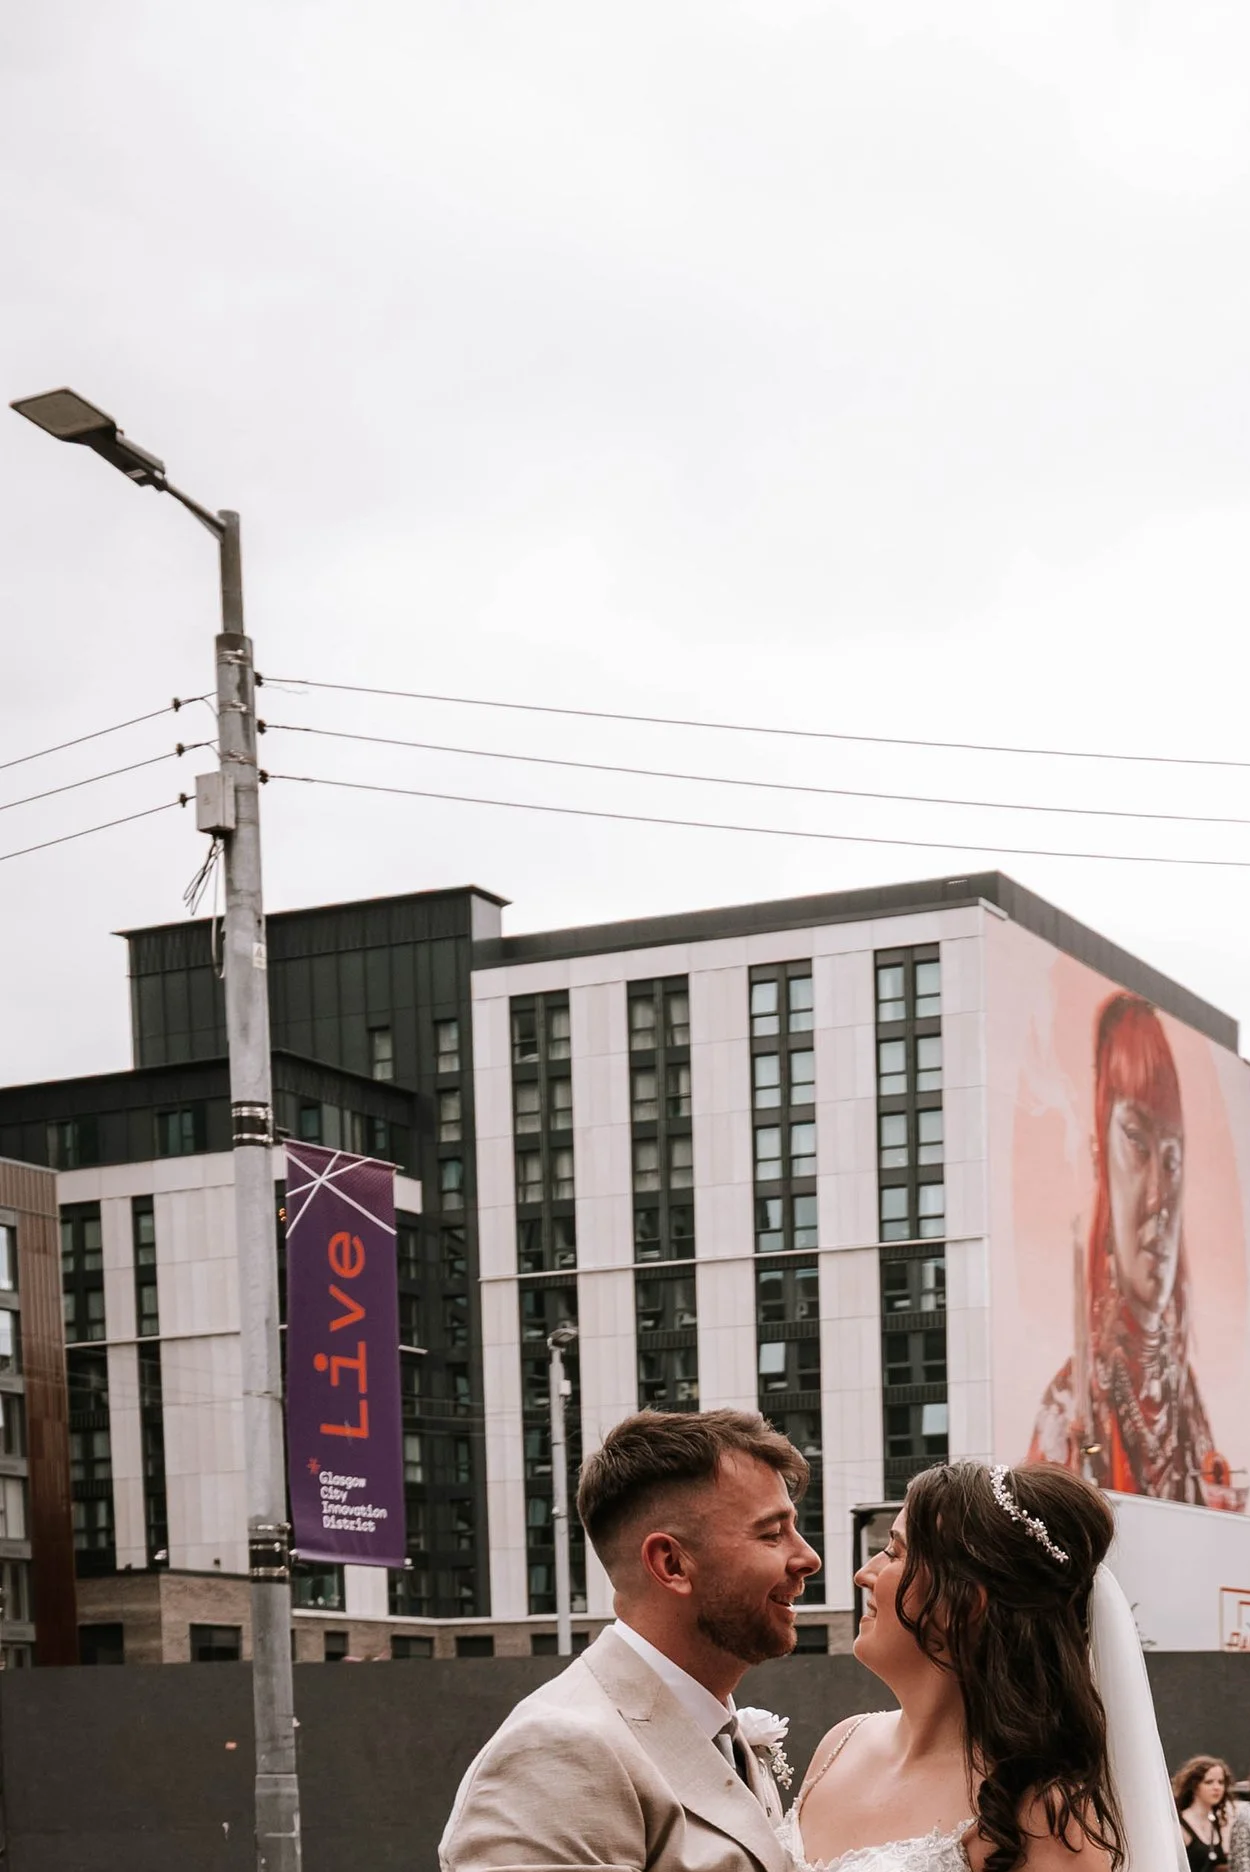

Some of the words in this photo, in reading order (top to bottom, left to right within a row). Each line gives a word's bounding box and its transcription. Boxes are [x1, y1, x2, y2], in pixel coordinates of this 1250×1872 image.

[313, 1231, 369, 1439] Live
[319, 1471, 367, 1490] Glasgow
[320, 1485, 348, 1503] City
[321, 1500, 388, 1519] Innovation
[322, 1514, 376, 1533] District
